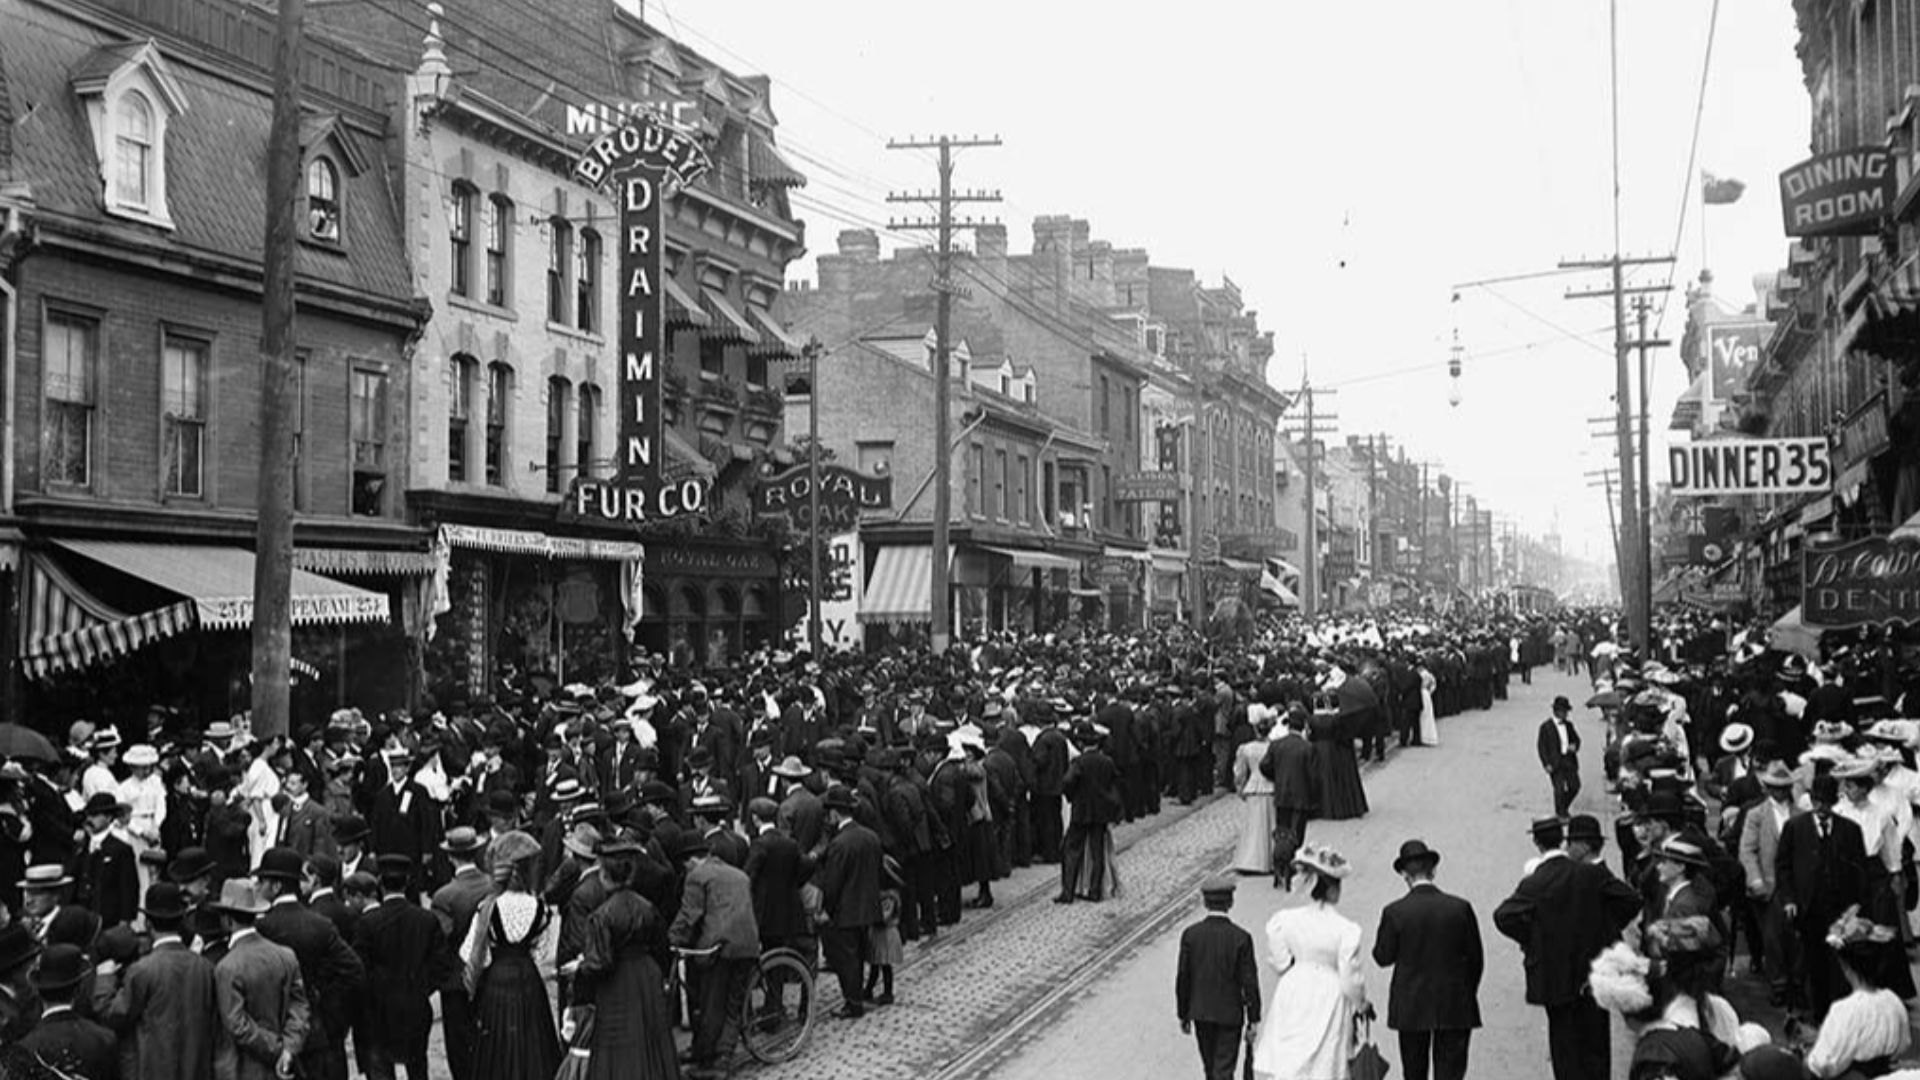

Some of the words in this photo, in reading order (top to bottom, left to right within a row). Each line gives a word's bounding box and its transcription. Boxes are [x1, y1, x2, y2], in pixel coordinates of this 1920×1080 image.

[577, 126, 706, 182] BRODEY
[1785, 153, 1888, 199] DINING
[1795, 187, 1883, 226] ROOM
[626, 177, 652, 465] DRAIMIN
[1670, 446, 1781, 489] DINNER
[577, 484, 645, 520] FUR
[658, 479, 706, 517] CO.
[766, 474, 881, 506] ROYAL
[799, 504, 849, 522] OAK
[660, 550, 721, 568] ROYAL
